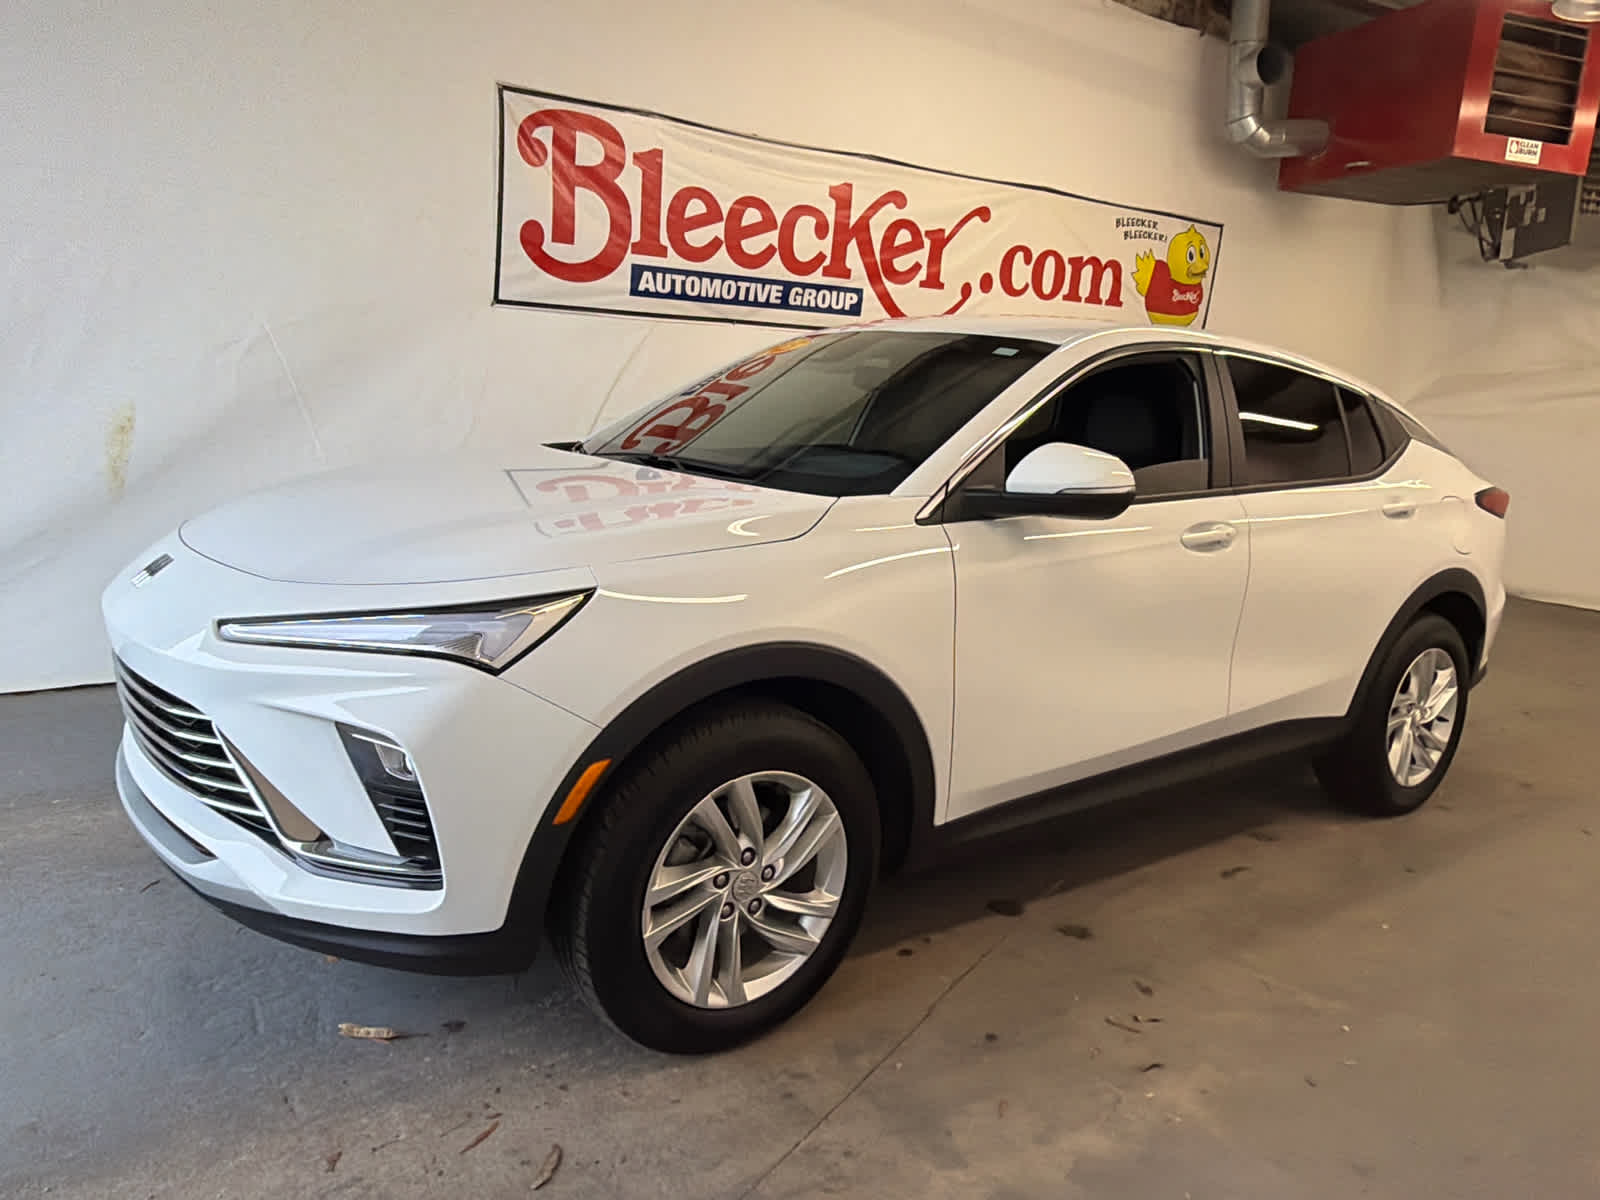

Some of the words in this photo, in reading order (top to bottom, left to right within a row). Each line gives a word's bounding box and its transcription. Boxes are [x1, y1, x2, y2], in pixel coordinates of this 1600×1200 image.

[1519, 148, 1538, 156] BURN
[637, 270, 783, 305] AUTOMOTIVE
[788, 287, 859, 311] GROUP
